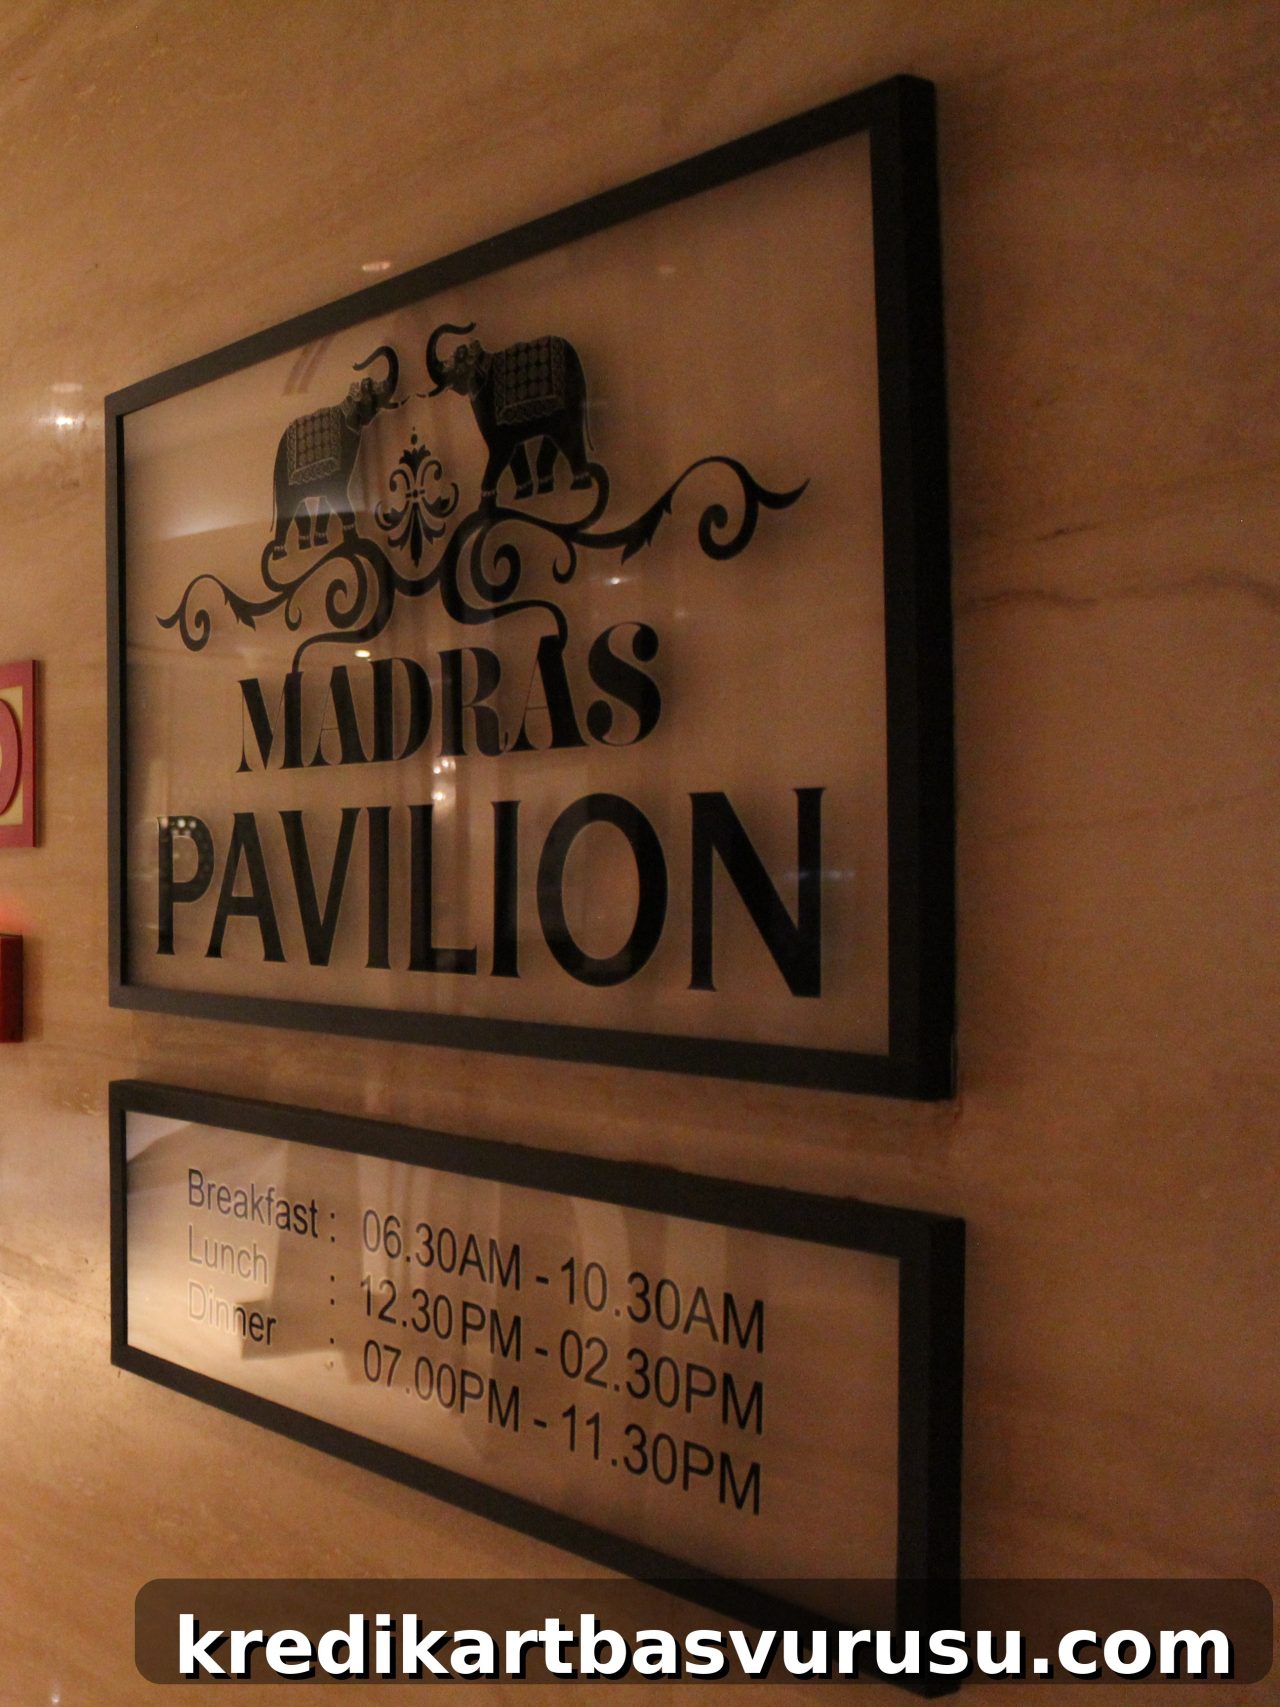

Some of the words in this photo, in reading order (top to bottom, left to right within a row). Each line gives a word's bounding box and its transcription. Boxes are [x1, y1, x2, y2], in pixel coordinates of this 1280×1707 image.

[236, 621, 661, 773] MADRAS
[157, 787, 826, 998] PAVILION
[188, 1168, 318, 1239] Breakfast
[363, 1209, 520, 1291] 06.30AM
[561, 1257, 764, 1353] 10.30AM
[188, 1225, 269, 1285] Lunch
[560, 1329, 763, 1435] 02.30PM
[188, 1281, 276, 1346] Dinner
[363, 1339, 519, 1432] 07.00PM
[562, 1404, 761, 1515] 11.30PM
